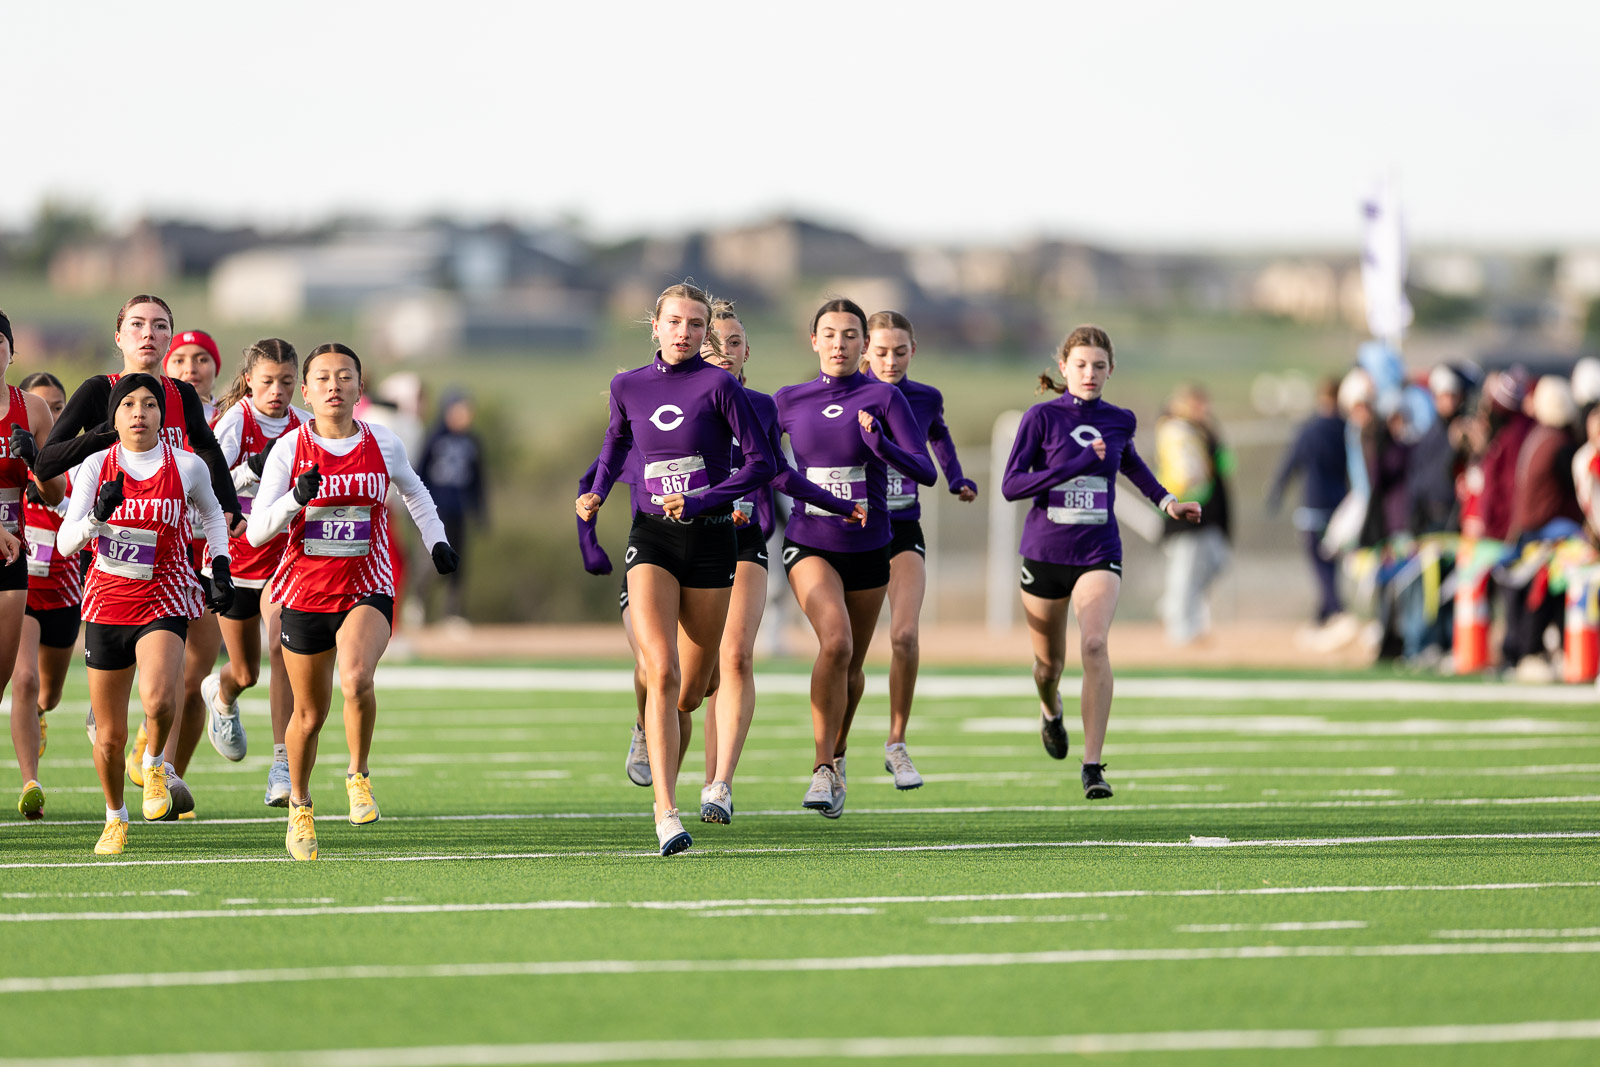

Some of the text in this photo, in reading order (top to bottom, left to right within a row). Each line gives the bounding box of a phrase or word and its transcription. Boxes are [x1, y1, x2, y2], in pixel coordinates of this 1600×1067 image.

[310, 472, 386, 504] RRYTON
[661, 473, 691, 495] 867
[1064, 491, 1095, 509] 858
[110, 498, 182, 529] RYTON
[704, 513, 734, 526] NIK
[322, 521, 355, 540] 973
[108, 540, 140, 562] 972
